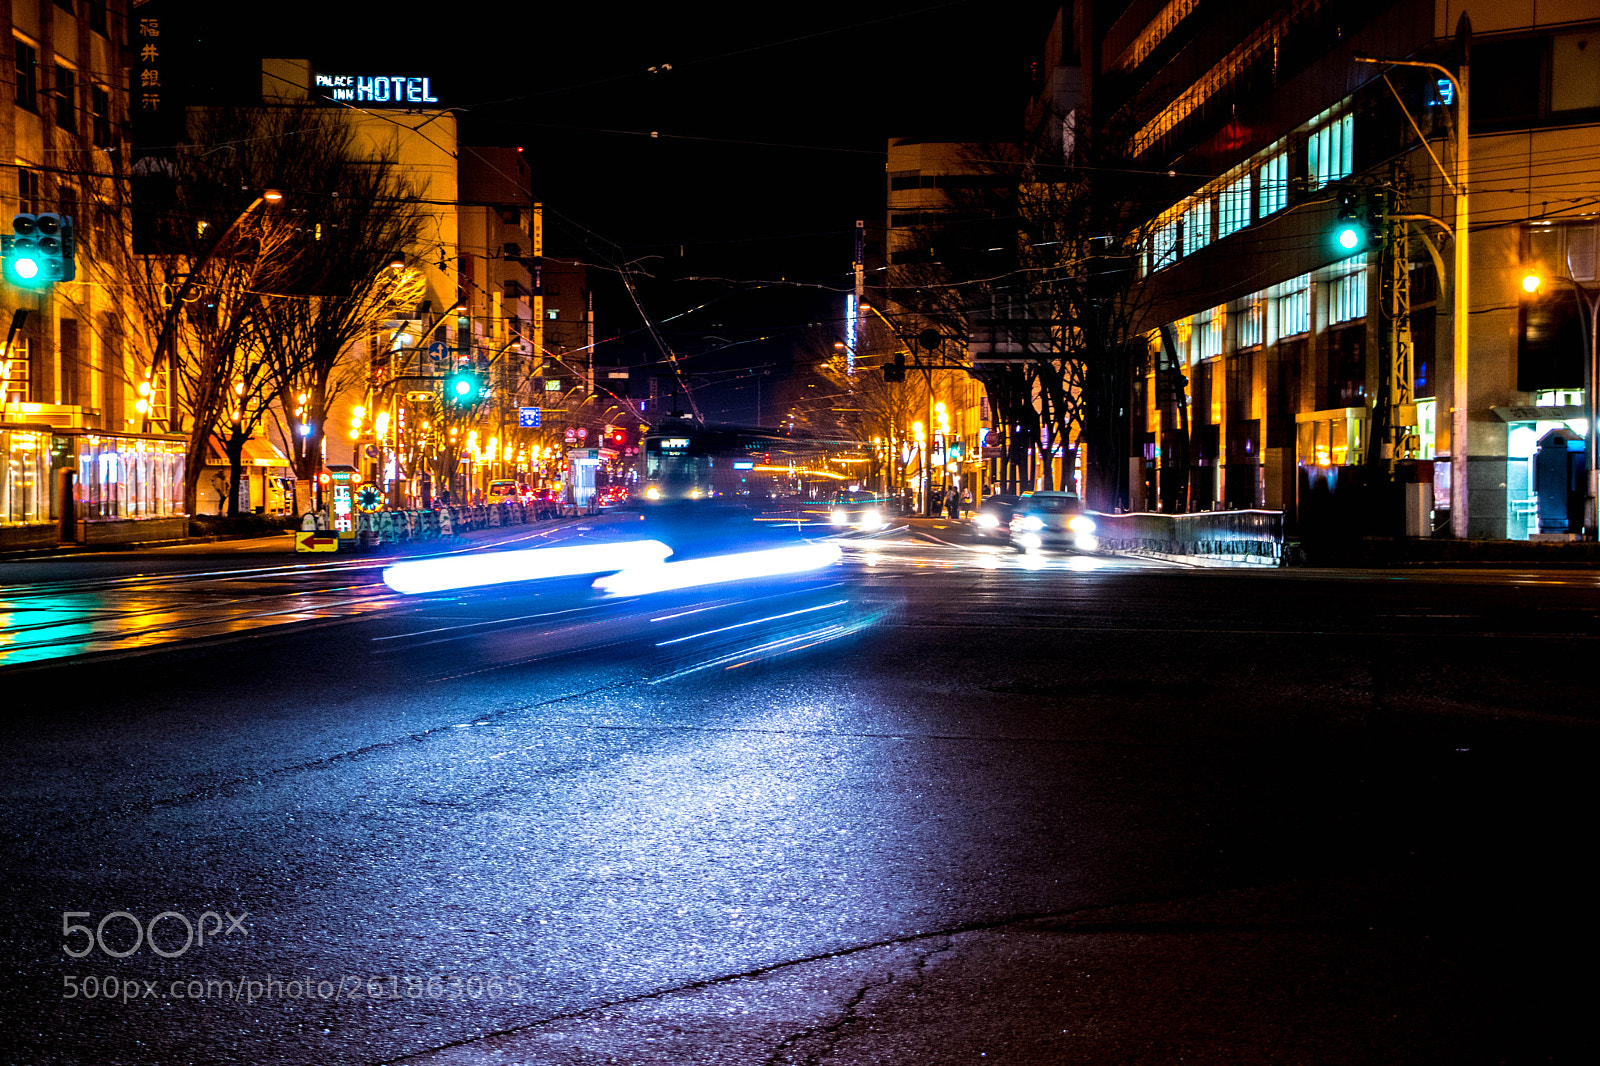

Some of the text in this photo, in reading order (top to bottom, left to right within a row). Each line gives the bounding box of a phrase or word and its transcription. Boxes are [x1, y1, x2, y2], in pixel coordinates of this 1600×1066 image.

[139, 18, 161, 111] 福井銀行
[315, 75, 355, 87] PALACE
[357, 75, 439, 103] HOTEL
[332, 88, 355, 101] INN
